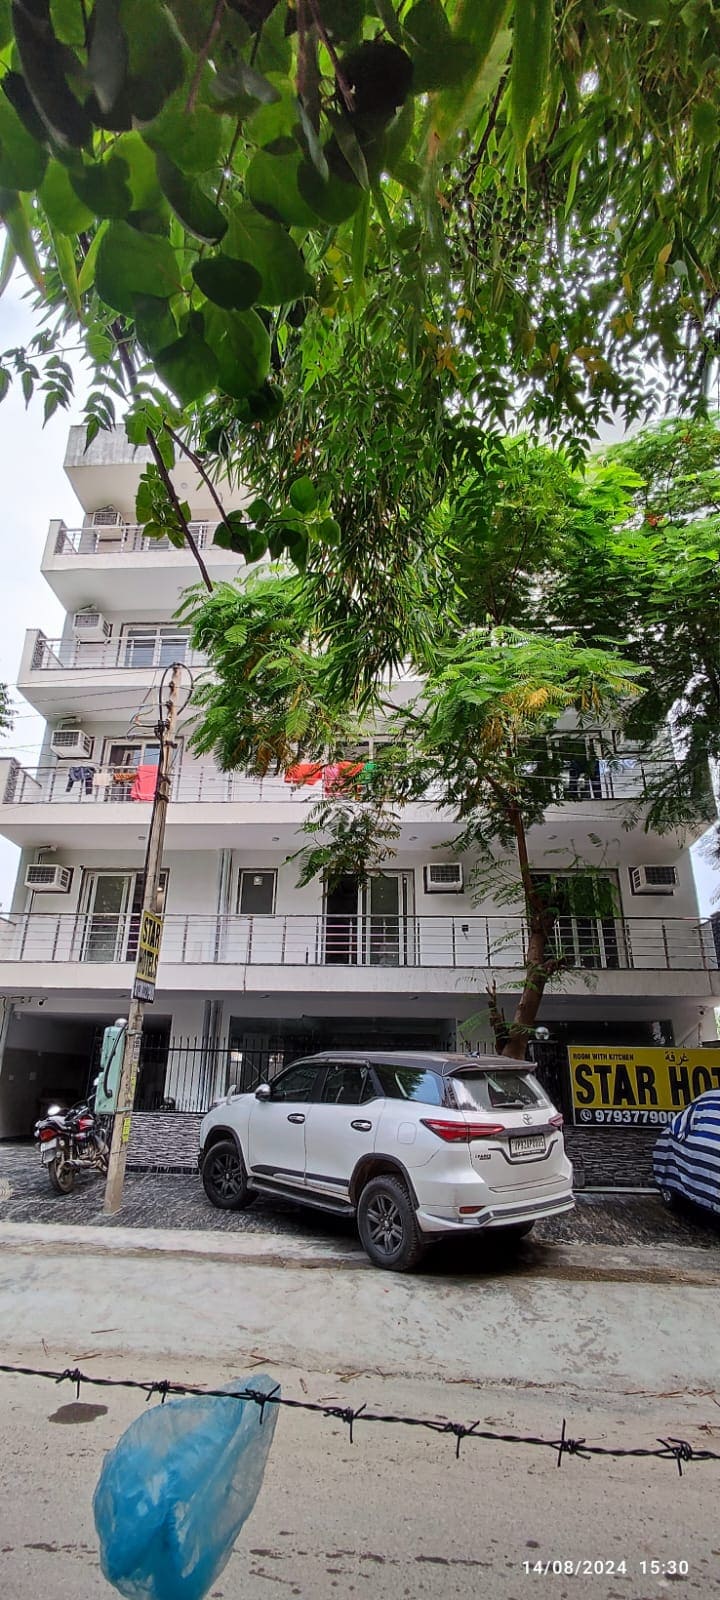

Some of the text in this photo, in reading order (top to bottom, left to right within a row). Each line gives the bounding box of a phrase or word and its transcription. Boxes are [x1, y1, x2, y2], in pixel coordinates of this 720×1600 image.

[142, 916, 161, 950] STAR
[592, 1053, 608, 1061] WITH
[575, 1064, 658, 1106] STAR
[595, 1109, 682, 1124] 979377900
